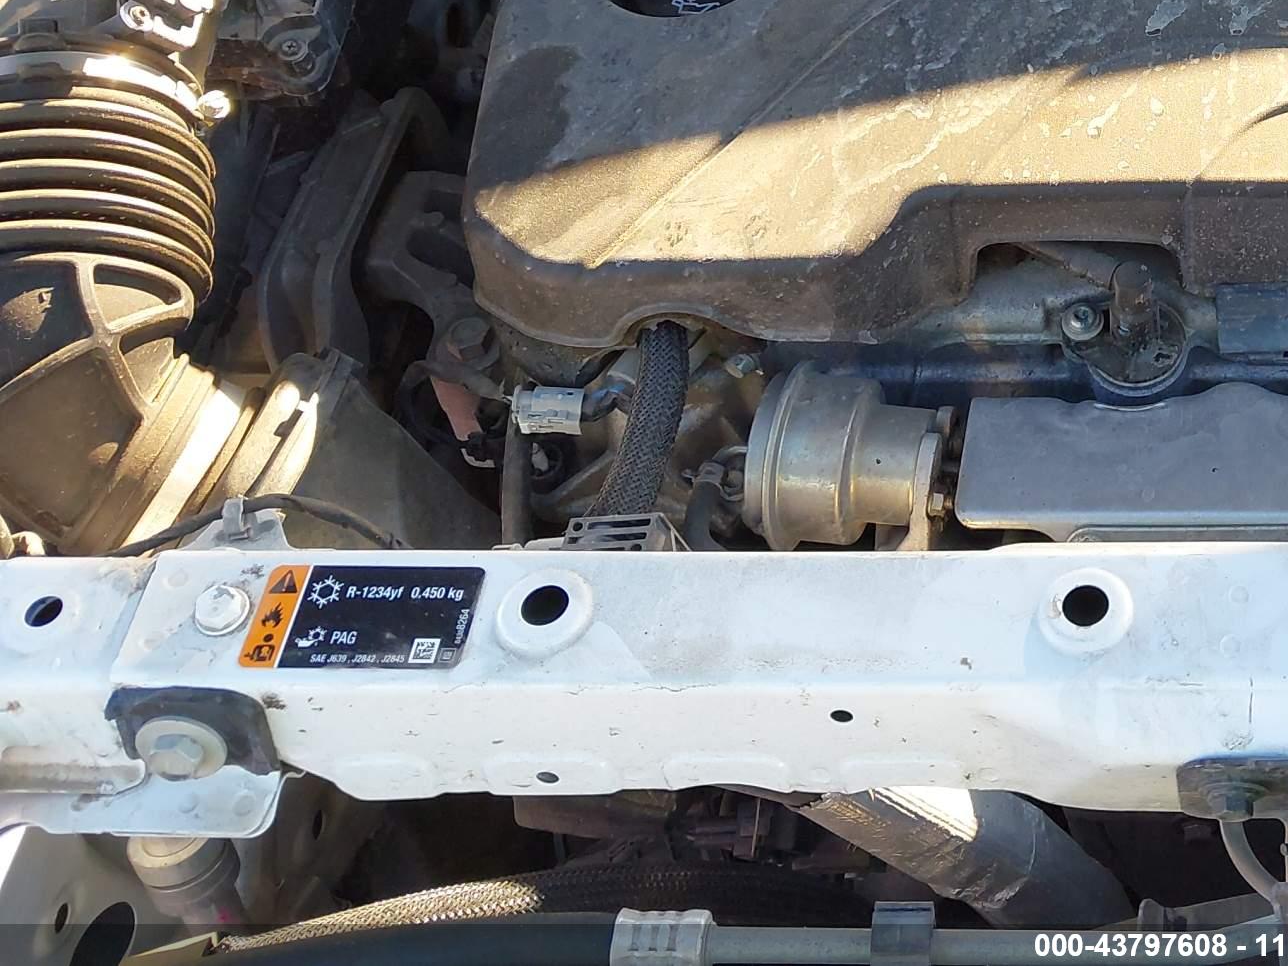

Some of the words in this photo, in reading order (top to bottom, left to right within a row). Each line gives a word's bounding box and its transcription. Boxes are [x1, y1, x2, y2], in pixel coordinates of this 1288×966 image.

[346, 586, 404, 600] R-1234yf
[411, 587, 447, 599] 0.450
[447, 586, 464, 601] kg
[330, 631, 357, 645] PAG
[310, 654, 327, 663] SAE
[381, 654, 405, 663] J2845
